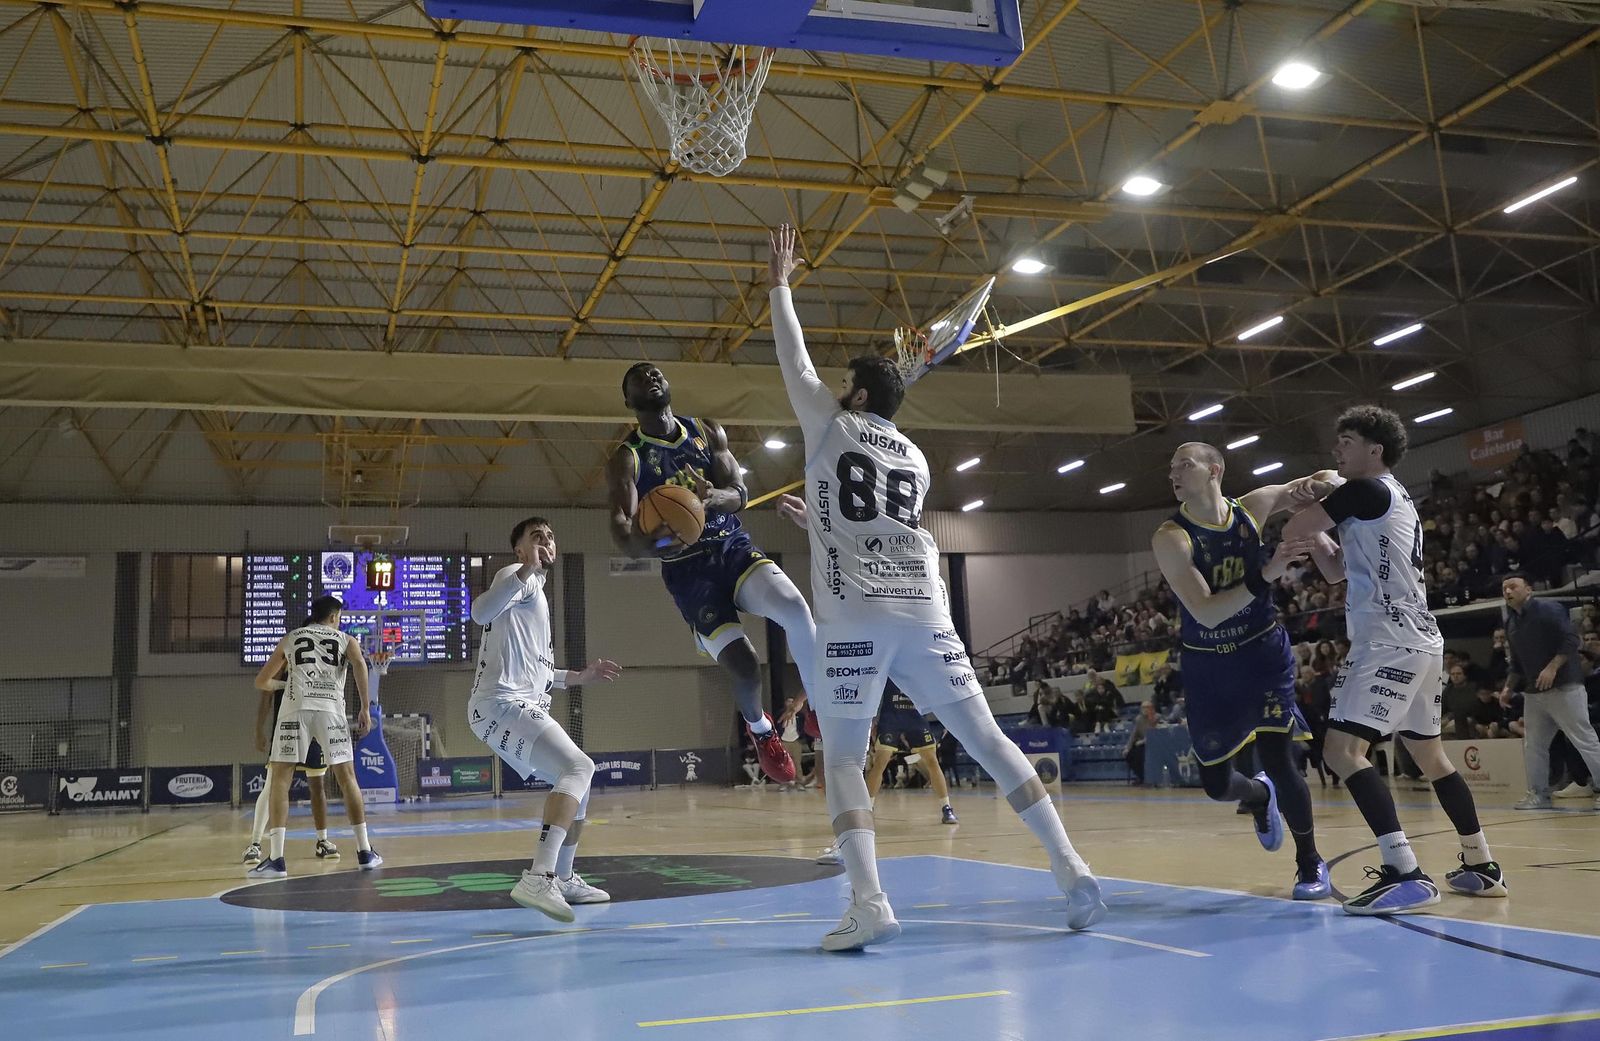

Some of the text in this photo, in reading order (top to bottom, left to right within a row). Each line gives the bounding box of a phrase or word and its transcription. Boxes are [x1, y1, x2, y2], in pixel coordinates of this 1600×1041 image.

[859, 432, 907, 457] DUSAN
[817, 480, 832, 533] RUSTER
[888, 534, 916, 546] ORO
[375, 572, 391, 587] 10
[294, 637, 339, 667] 23
[836, 667, 861, 677] EOM
[1379, 686, 1398, 700] EOM
[361, 756, 385, 766] TME
[74, 789, 141, 802] GRAMMY
